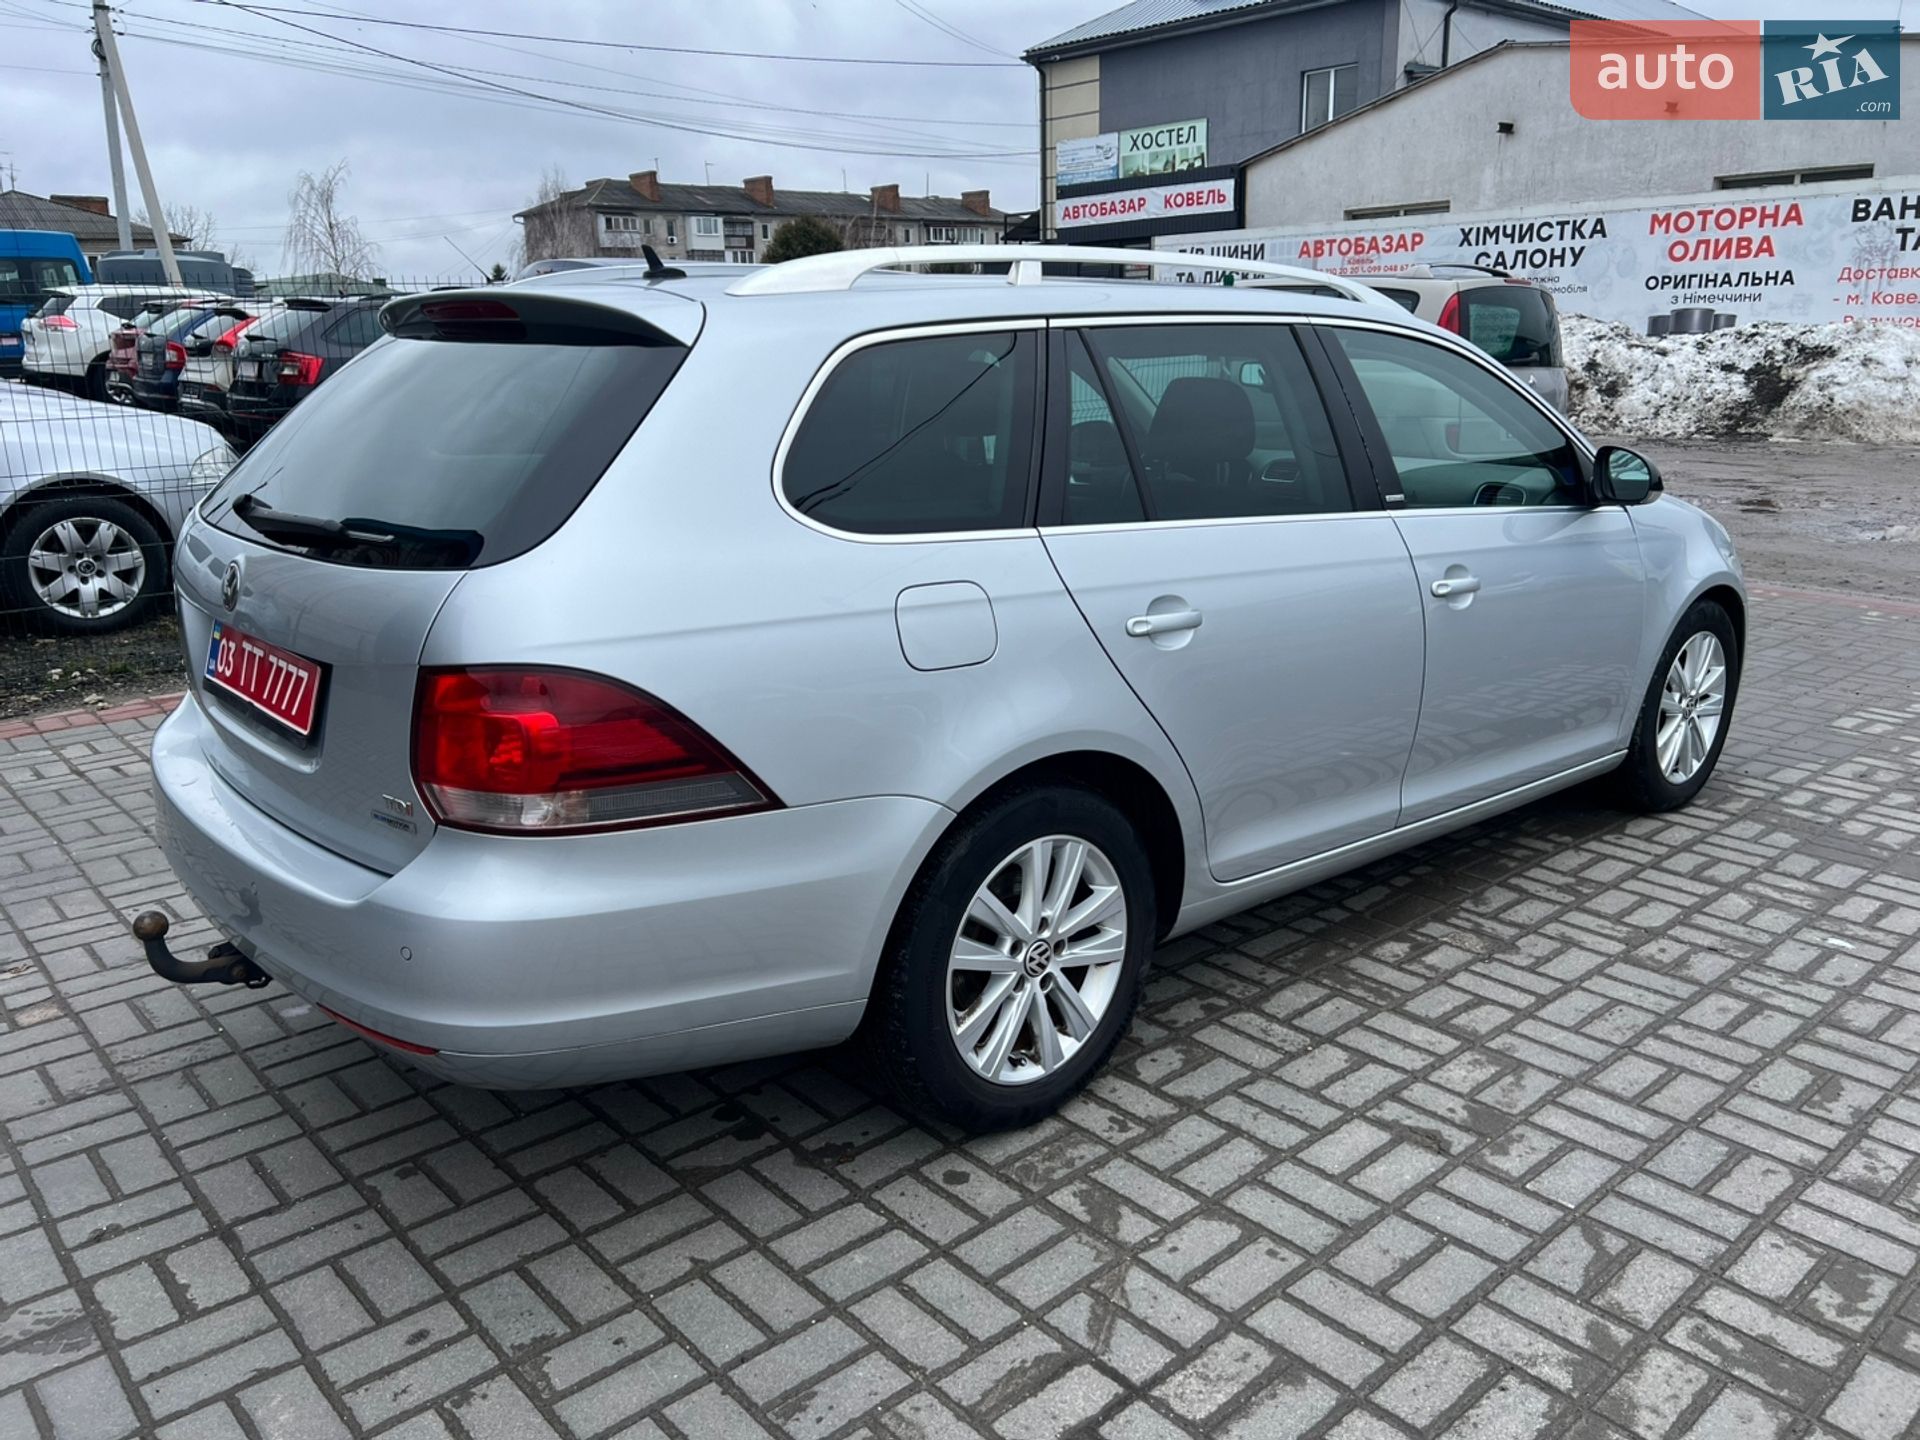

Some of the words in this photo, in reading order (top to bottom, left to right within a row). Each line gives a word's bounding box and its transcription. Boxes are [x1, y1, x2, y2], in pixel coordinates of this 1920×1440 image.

[1129, 125, 1197, 152] ХОСТЕЛ
[1062, 197, 1147, 221] АВТОБАЗАР
[1163, 188, 1227, 210] КОВЕЛЬ
[1458, 217, 1608, 247] ХІМЧИСТКА
[1649, 203, 1804, 236] МОТОРНА
[1298, 232, 1424, 259] АВТОБАЗАР
[1474, 245, 1587, 270] САЛОНУ
[1667, 235, 1775, 263] ОЛИВА
[1645, 270, 1795, 291] ОРИГІНАЛЬНА
[1683, 291, 1762, 304] Німеччини
[1871, 291, 1920, 305] Кове
[217, 637, 236, 678] 03
[240, 641, 264, 693] TT
[263, 654, 309, 716] 7777
